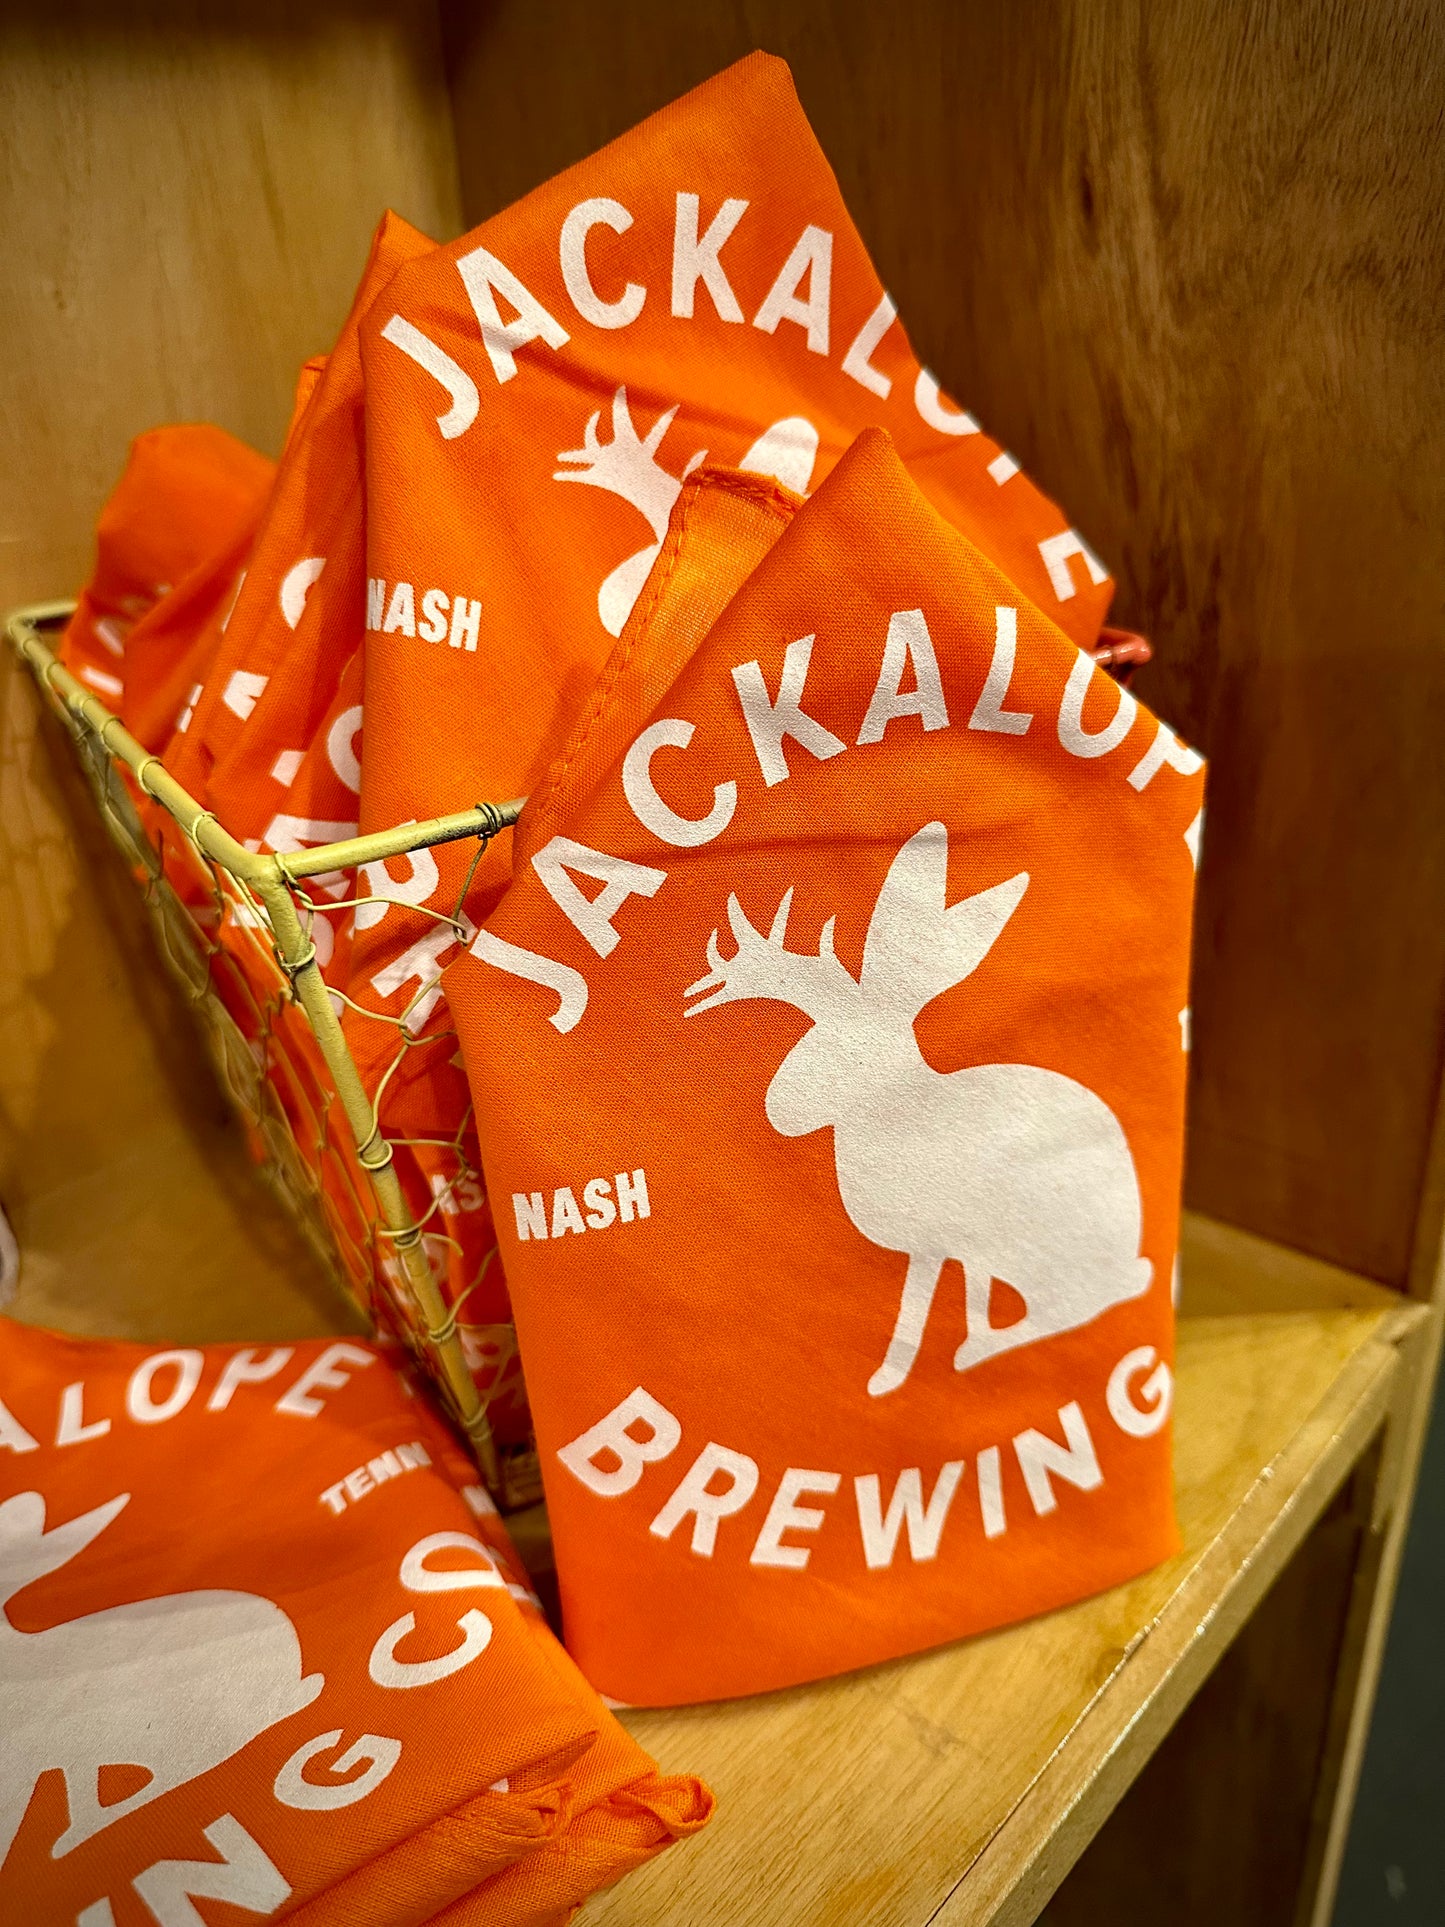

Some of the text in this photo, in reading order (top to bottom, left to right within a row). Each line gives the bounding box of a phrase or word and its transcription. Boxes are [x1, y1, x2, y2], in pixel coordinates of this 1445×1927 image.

[366, 577, 482, 652] NASH
[512, 1168, 652, 1240] NASH
[319, 1440, 432, 1516] TENN
[557, 1345, 1173, 1569] BREWING
